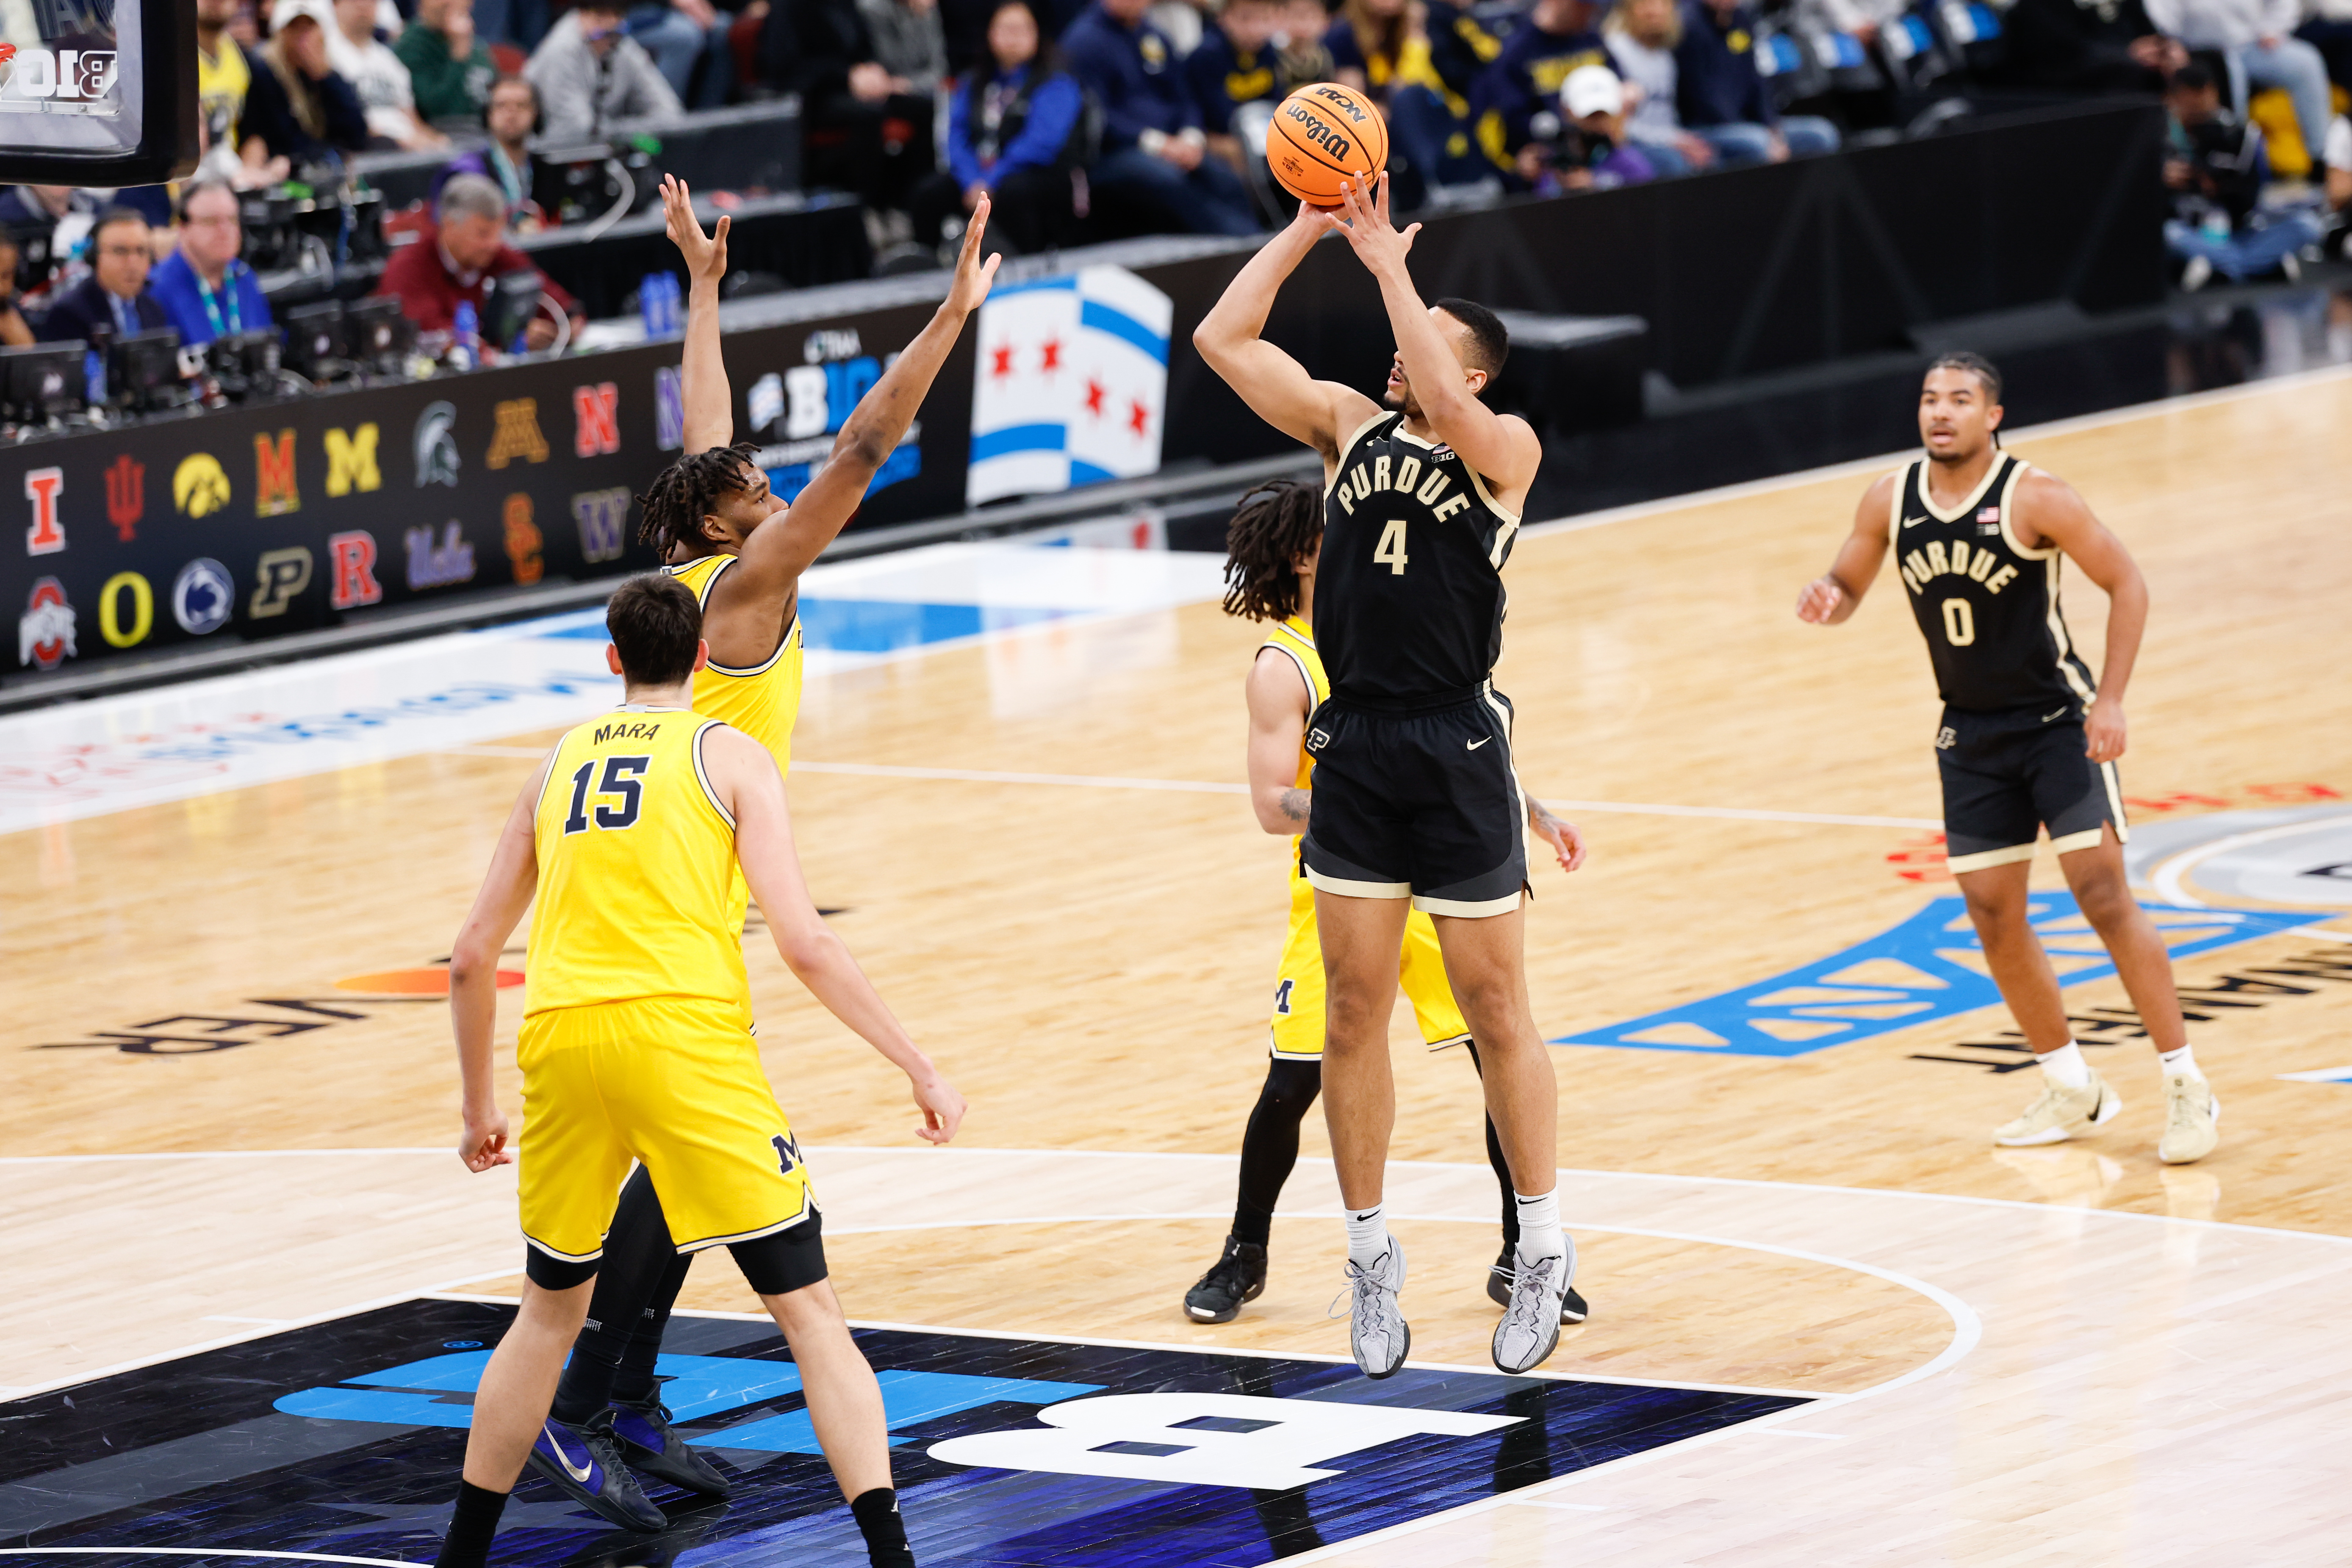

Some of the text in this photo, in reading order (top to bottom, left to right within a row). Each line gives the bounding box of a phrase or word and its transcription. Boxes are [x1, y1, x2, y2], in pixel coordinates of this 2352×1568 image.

[1287, 104, 1349, 162] Wilson
[1315, 87, 1366, 122] NCAA
[573, 382, 620, 458] N
[324, 422, 382, 498] M
[1337, 455, 1471, 524] PURDUE
[572, 486, 632, 563] W
[1374, 520, 1408, 575] 4
[249, 547, 312, 619] P
[329, 530, 382, 610] R
[1901, 540, 2020, 595] PURDUE
[99, 571, 153, 648] O
[1942, 598, 1975, 646] 0
[594, 723, 661, 745] MARA
[1308, 728, 1330, 752] P
[564, 754, 653, 837] 15
[1274, 978, 1295, 1015] M
[771, 1129, 804, 1175] M
